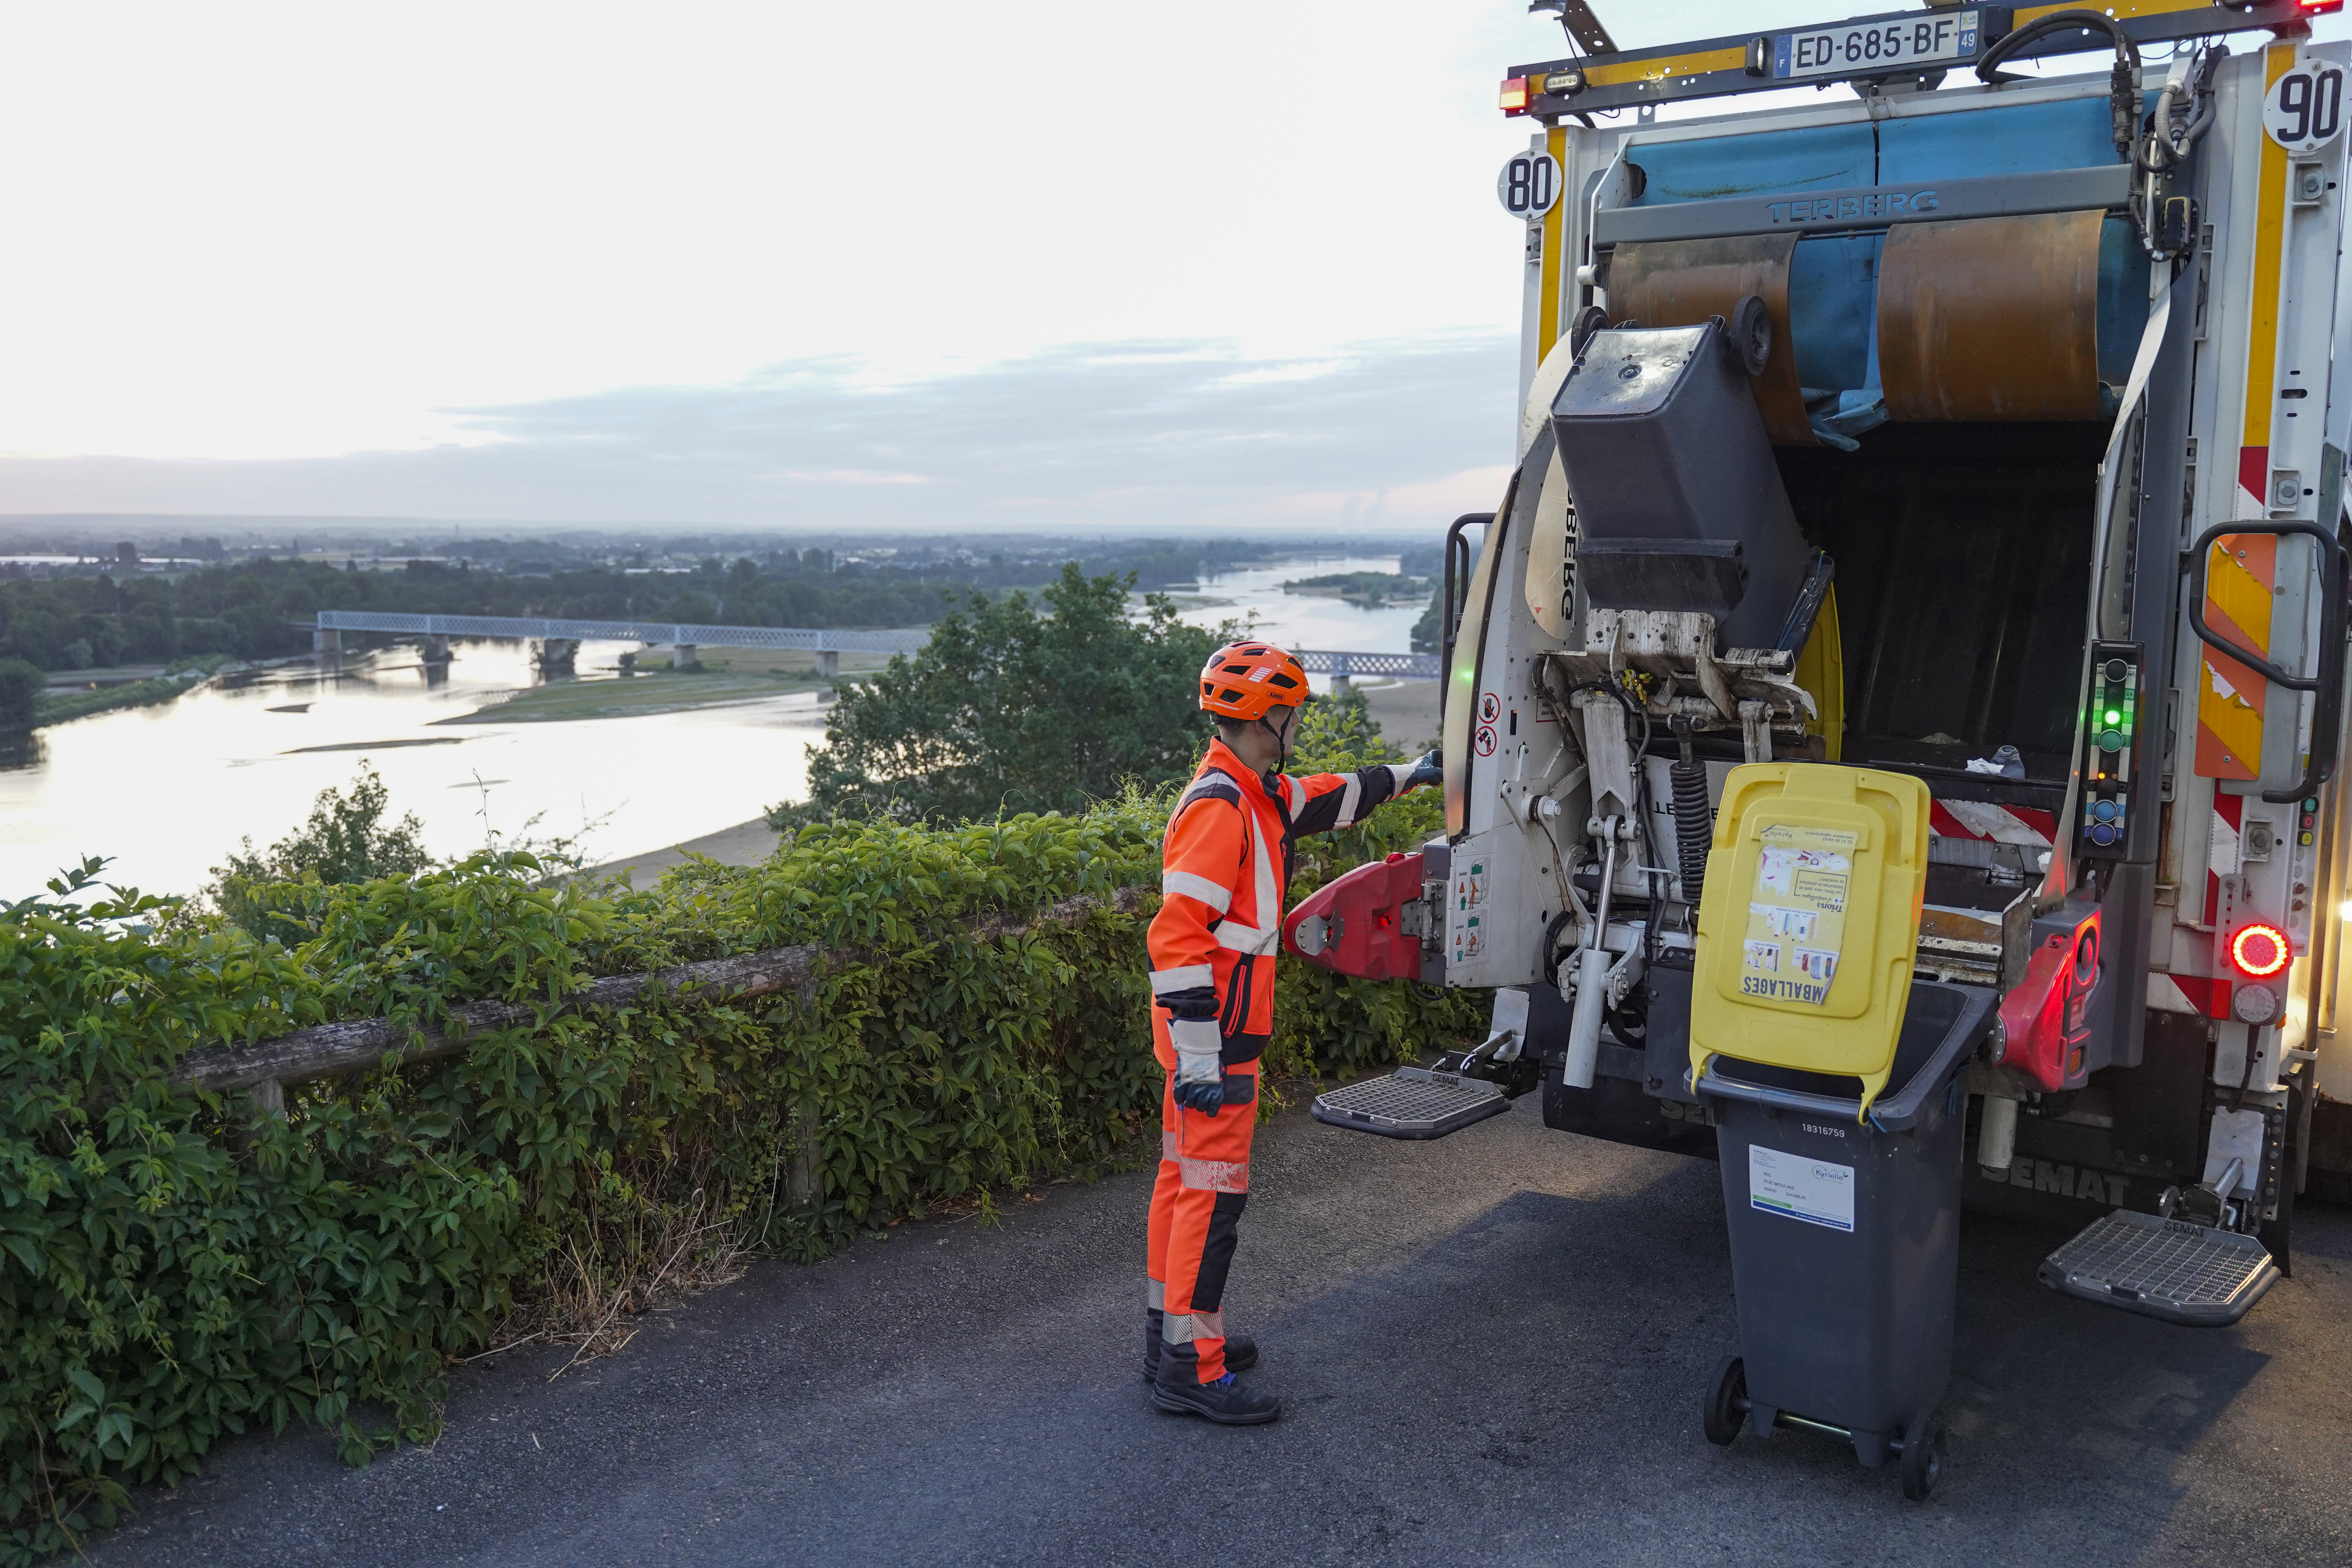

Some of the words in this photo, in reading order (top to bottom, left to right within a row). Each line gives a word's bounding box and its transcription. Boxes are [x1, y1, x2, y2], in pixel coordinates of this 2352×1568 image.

[1779, 59, 1785, 68] F
[1796, 20, 1954, 69] ED-685-BF
[1961, 33, 1975, 47] 49
[2277, 69, 2343, 142] 90
[1508, 156, 1552, 212] 80
[1765, 190, 1938, 223] TERBERG
[2122, 418, 2141, 636] ERBERG
[1817, 902, 1842, 912] Trions
[1802, 1123, 1845, 1137] 18316759
[1816, 1169, 1844, 1181] Kyrielle
[1774, 1182, 1795, 1190] MOULINS
[2165, 1221, 2205, 1237] SEMAT
